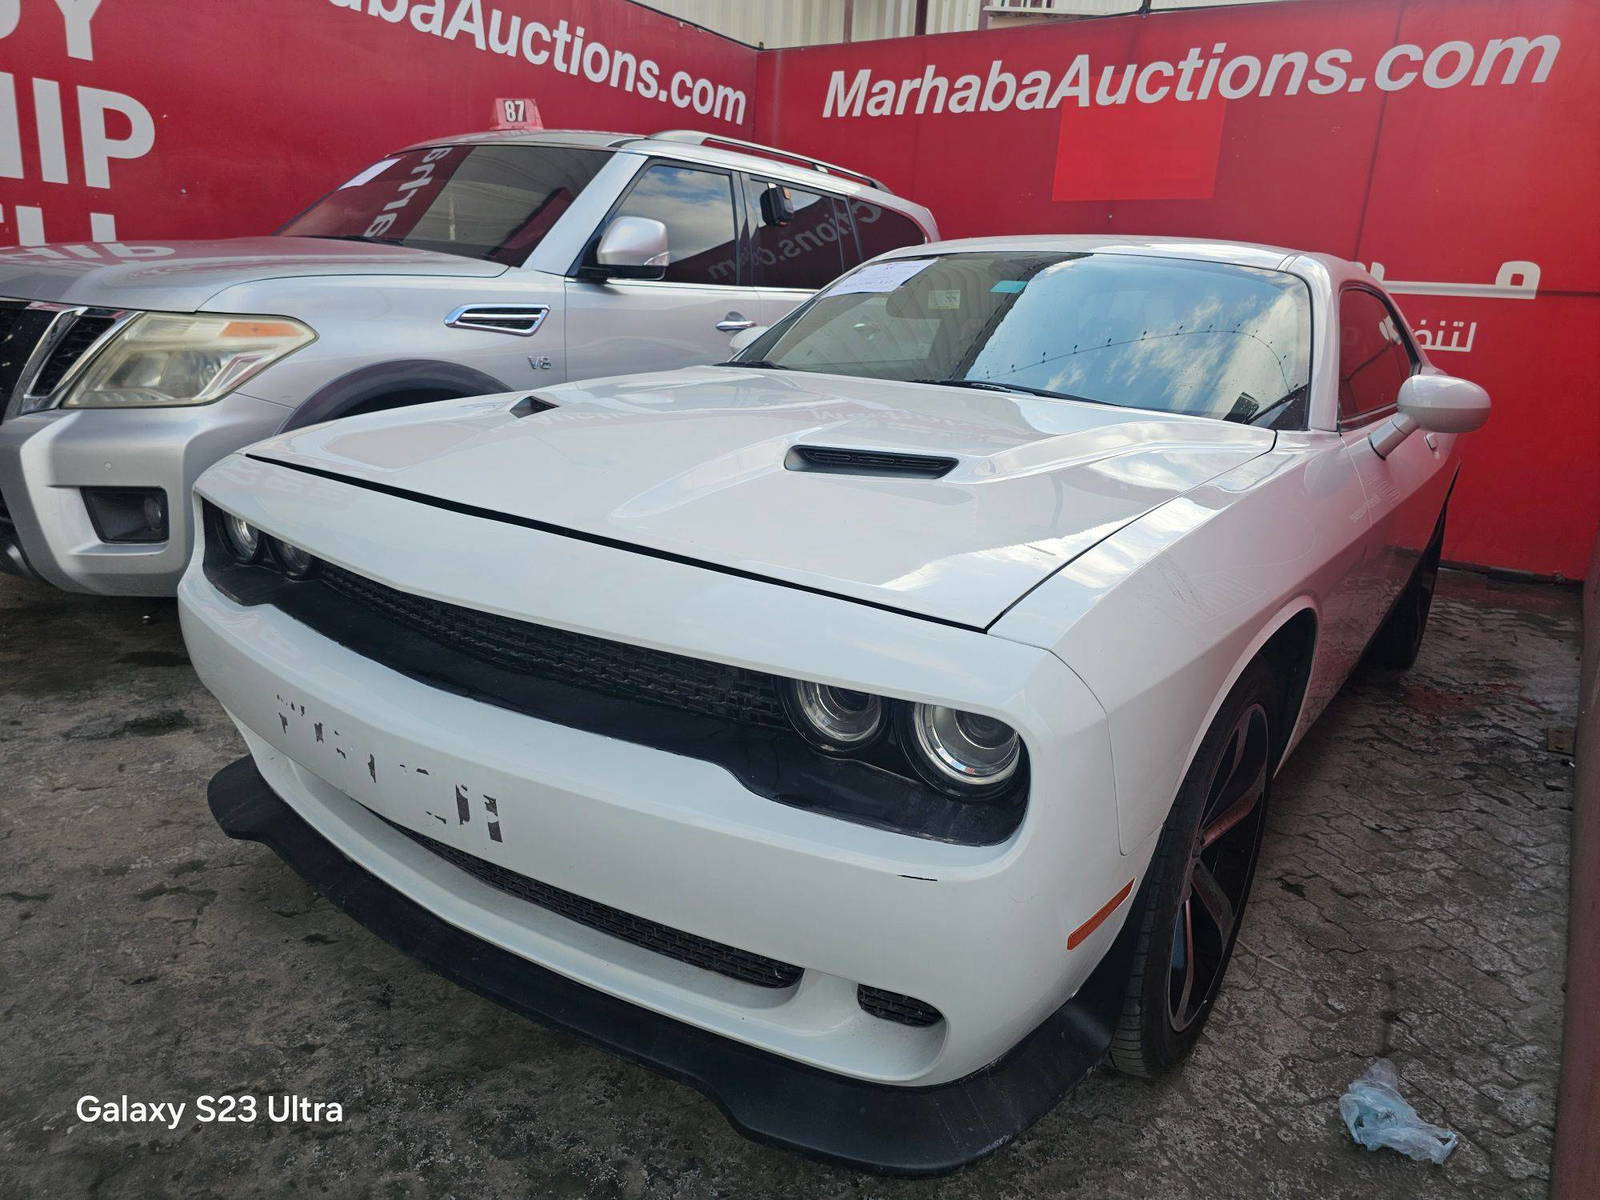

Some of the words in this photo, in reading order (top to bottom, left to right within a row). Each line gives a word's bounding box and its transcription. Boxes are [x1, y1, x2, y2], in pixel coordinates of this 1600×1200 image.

[822, 34, 1561, 119] MarhabaAuctions.com
[504, 100, 525, 122] 87
[527, 355, 552, 370] V8
